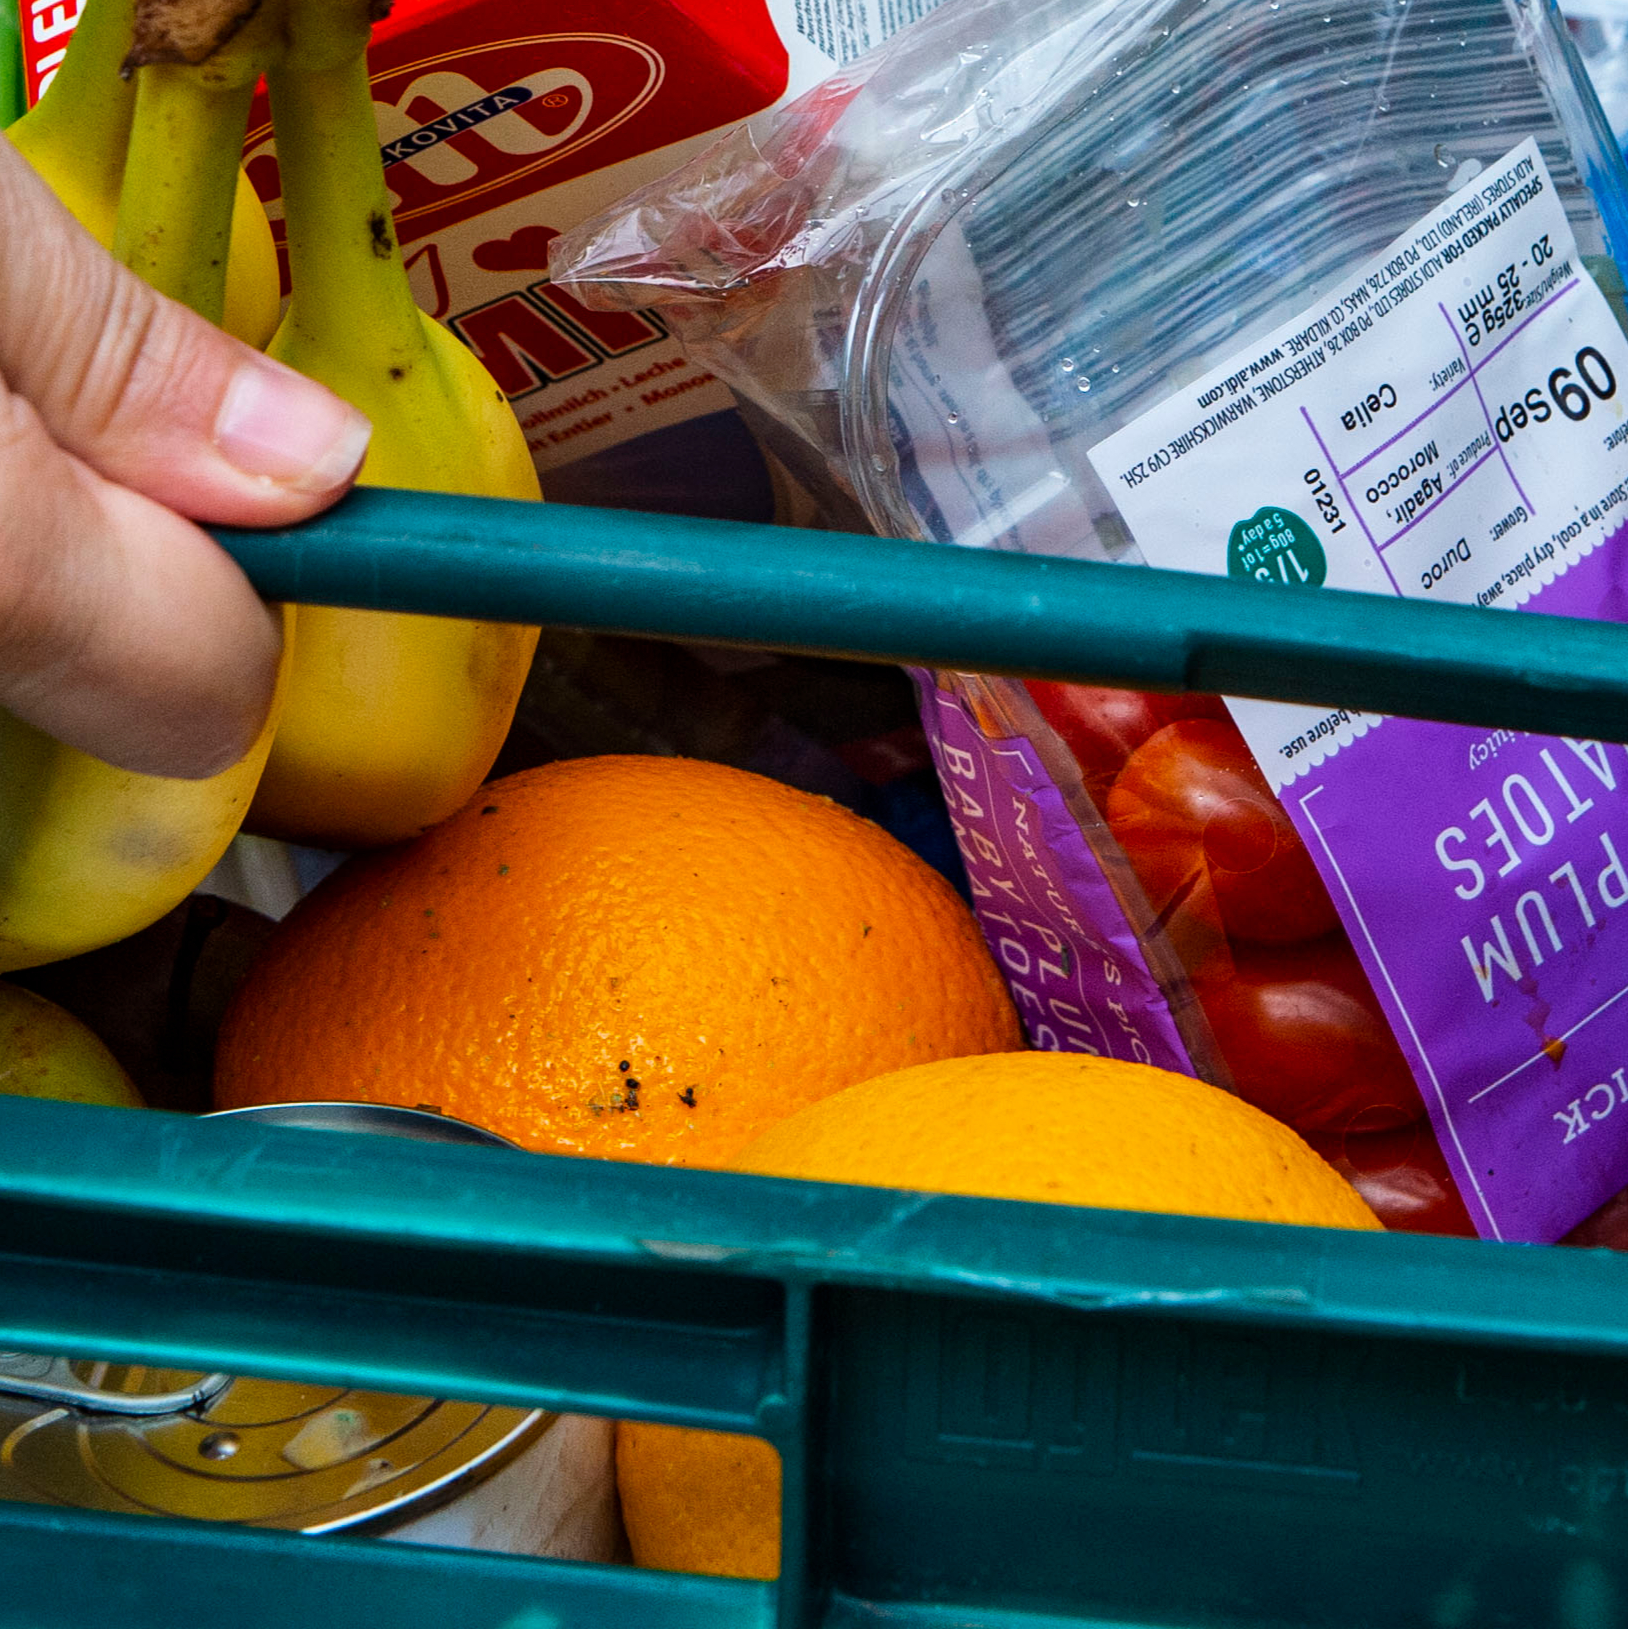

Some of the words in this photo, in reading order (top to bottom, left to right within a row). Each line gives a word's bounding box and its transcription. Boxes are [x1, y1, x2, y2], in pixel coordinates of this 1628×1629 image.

[381, 94, 520, 168] KOVITA
[1513, 155, 1535, 182] ALDI
[1481, 170, 1517, 206] STORES
[1498, 175, 1543, 222] SPECIALLY
[1436, 194, 1485, 240] (IRELAND)
[1461, 210, 1501, 249] PACKED
[1403, 244, 1421, 266] PO
[1419, 254, 1444, 281] ALDI
[1440, 239, 1465, 264] FOR
[1530, 233, 1554, 267] 20
[1365, 269, 1390, 294] 726,
[1383, 255, 1408, 281] BOX
[1496, 263, 1520, 298] 25
[1339, 284, 1371, 315] NAAS,
[1388, 270, 1424, 306] STORES
[1457, 284, 1495, 324] mm
[1327, 305, 1345, 326] CO.
[1356, 310, 1374, 332] PO
[1481, 288, 1530, 334] 325g
[1281, 316, 1333, 357] KILDARE.
[1323, 334, 1343, 356] 26,
[1338, 321, 1361, 347] BOX
[1196, 348, 1285, 409] www.aldi.com
[1251, 346, 1327, 403] ATHERSTONE,
[1428, 356, 1467, 392] Variety:
[1547, 345, 1617, 422] 09
[517, 382, 610, 432] ollmilch
[616, 352, 689, 391] Leche
[1340, 383, 1397, 431] Celia
[1167, 393, 1258, 460] WARWICKSHIRE
[1485, 387, 1552, 443] sep
[1147, 448, 1171, 473] CV9
[1457, 430, 1492, 466] Produce
[1365, 439, 1440, 504] Morocco
[1446, 458, 1460, 480] of:
[1303, 468, 1347, 534] 01231
[1386, 471, 1451, 524] Agadir,
[1587, 504, 1605, 521] in
[1599, 483, 1628, 512] Store
[1264, 518, 1271, 529] a
[1273, 513, 1284, 528] 5
[1489, 505, 1529, 542] Grower:
[1551, 521, 1582, 550] cool,
[1579, 513, 1591, 527] a
[1268, 528, 1295, 548] 80g
[1532, 542, 1555, 564] dry
[1242, 553, 1255, 569] of
[1421, 537, 1472, 590] Duroc
[1500, 554, 1536, 586] place,
[1476, 581, 1504, 614] away
[1306, 702, 1351, 743] before
[1279, 735, 1308, 759] use.
[1469, 728, 1516, 771] juicy
[941, 741, 1026, 904] BABY
[1106, 996, 1152, 1066] PIC
